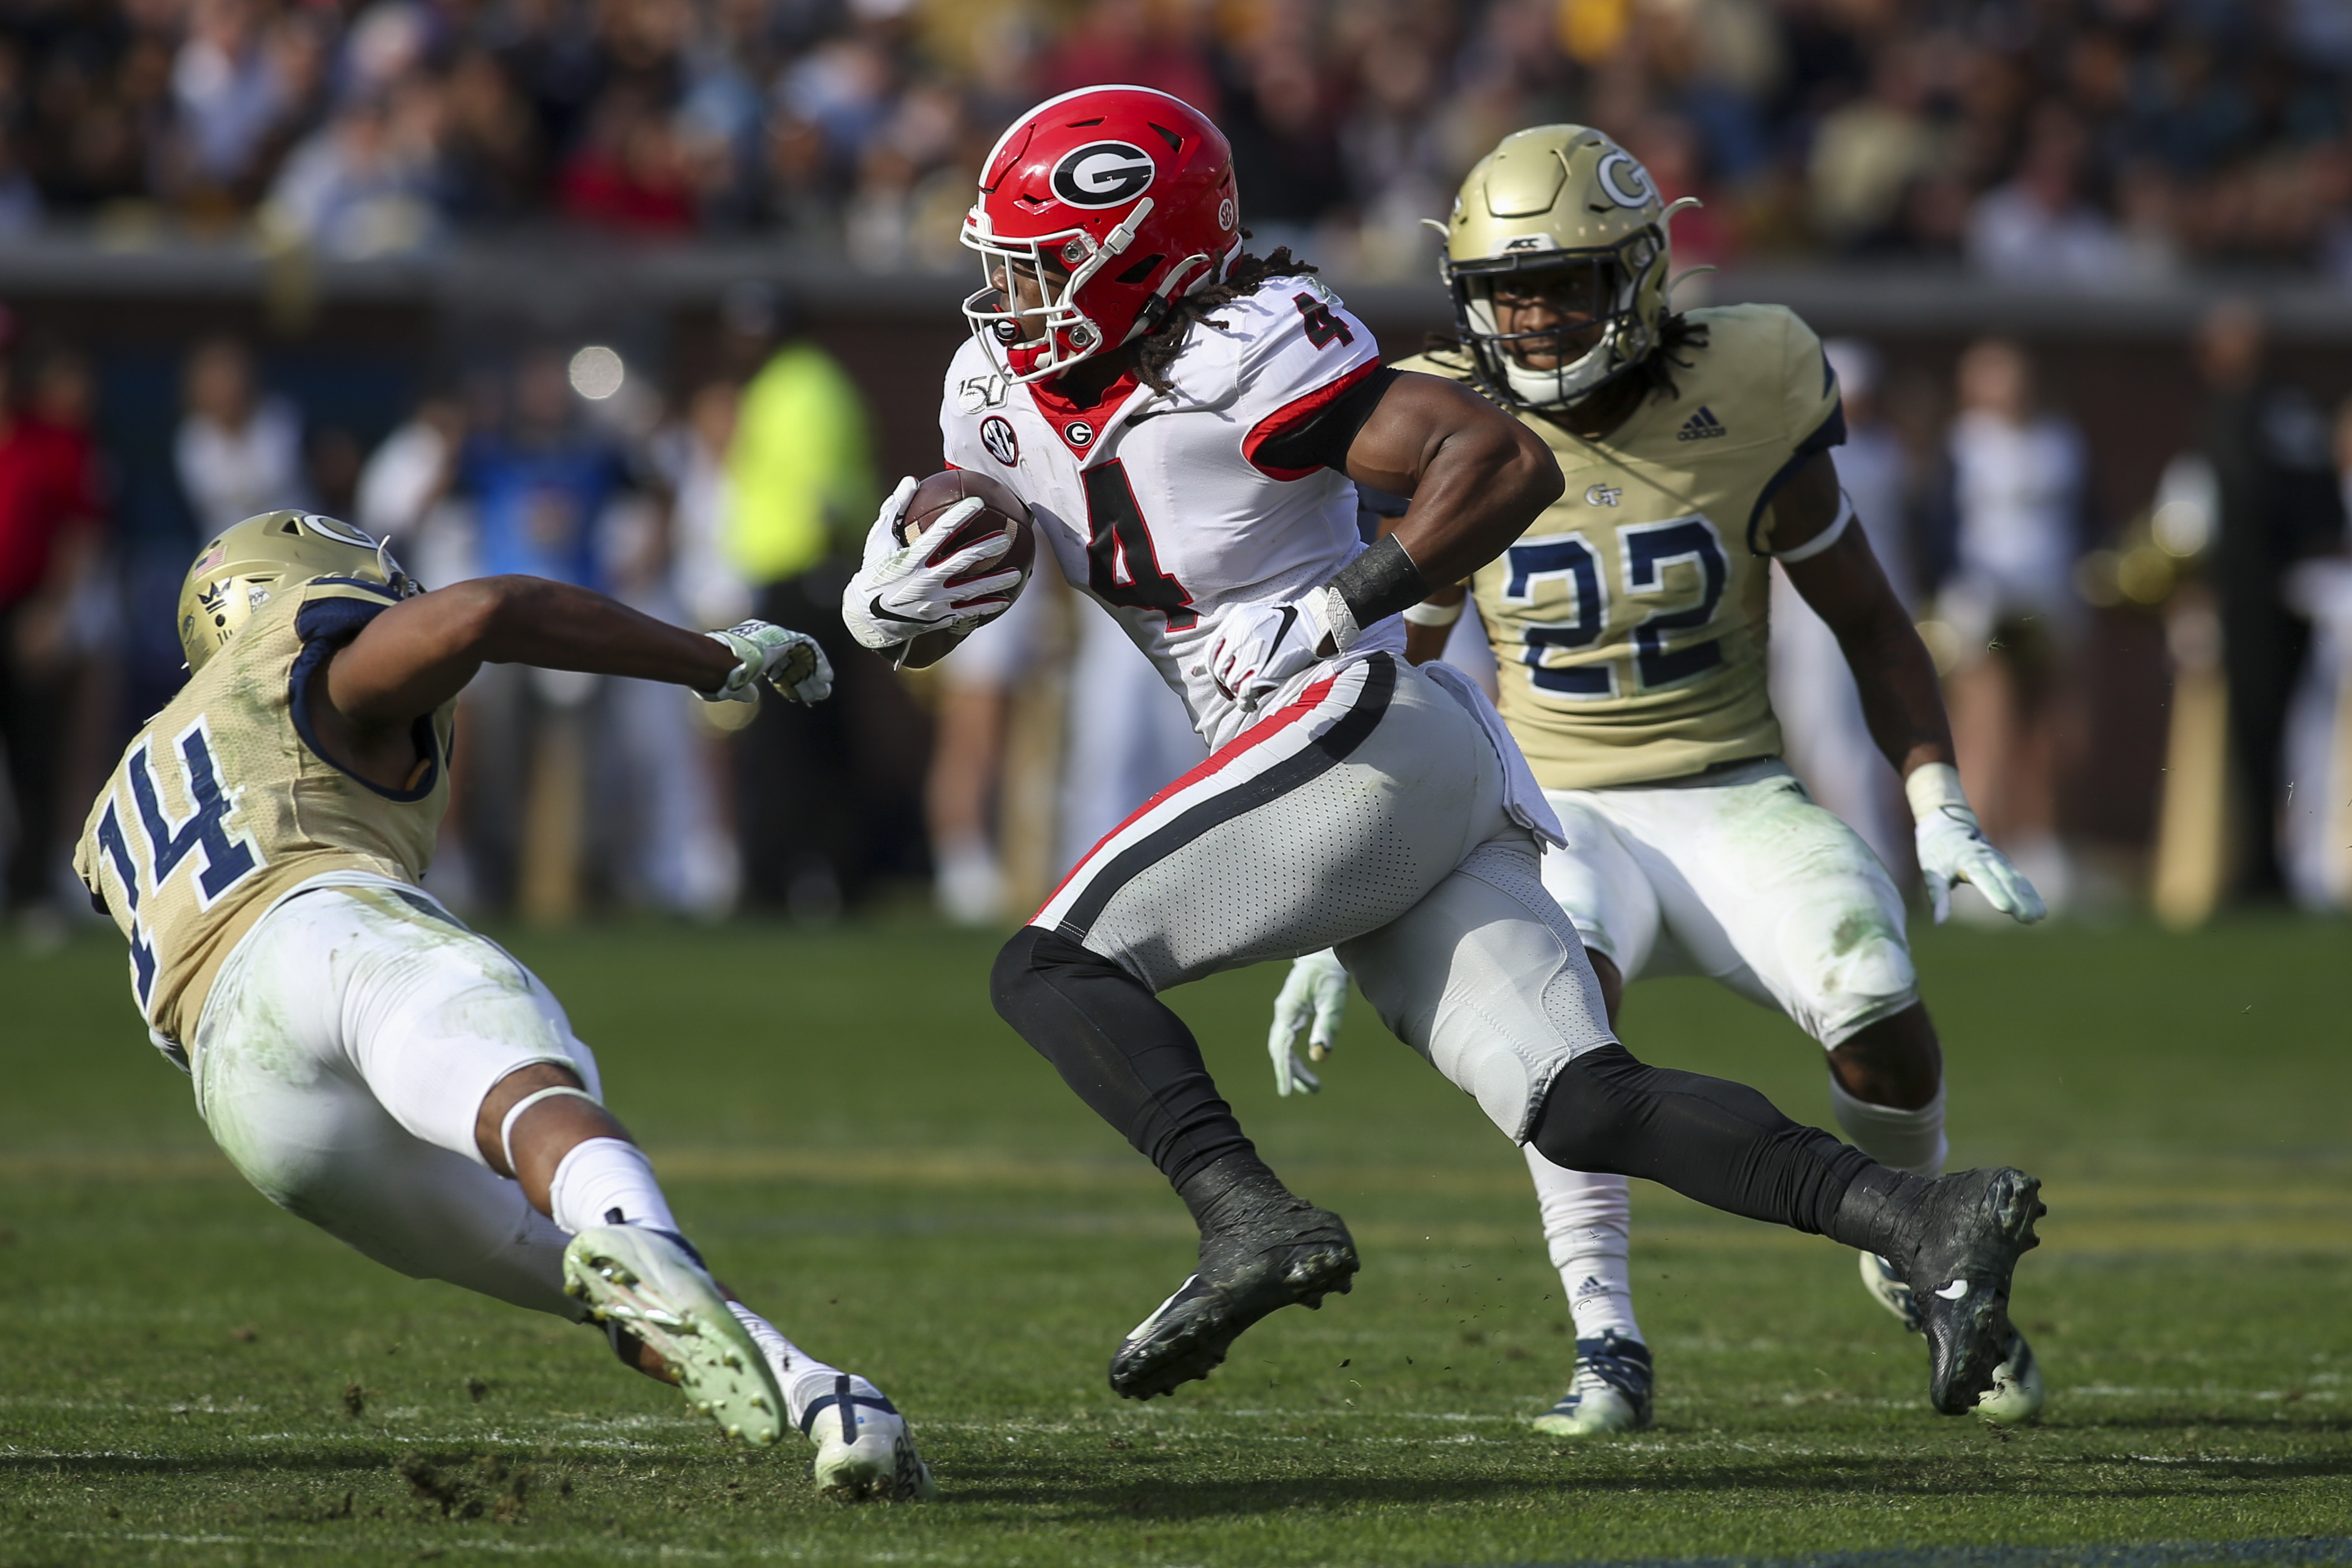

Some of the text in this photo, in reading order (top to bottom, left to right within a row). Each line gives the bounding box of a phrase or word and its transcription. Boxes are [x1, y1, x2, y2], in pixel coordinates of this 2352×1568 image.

[1053, 143, 1154, 206] G
[1506, 238, 1539, 250] ACC
[1292, 291, 1354, 350] 4
[1065, 423, 1092, 444] G
[1584, 483, 1623, 507] GT
[1082, 458, 1199, 632] 4
[1501, 513, 1731, 701] 22
[94, 712, 269, 1019] 14
